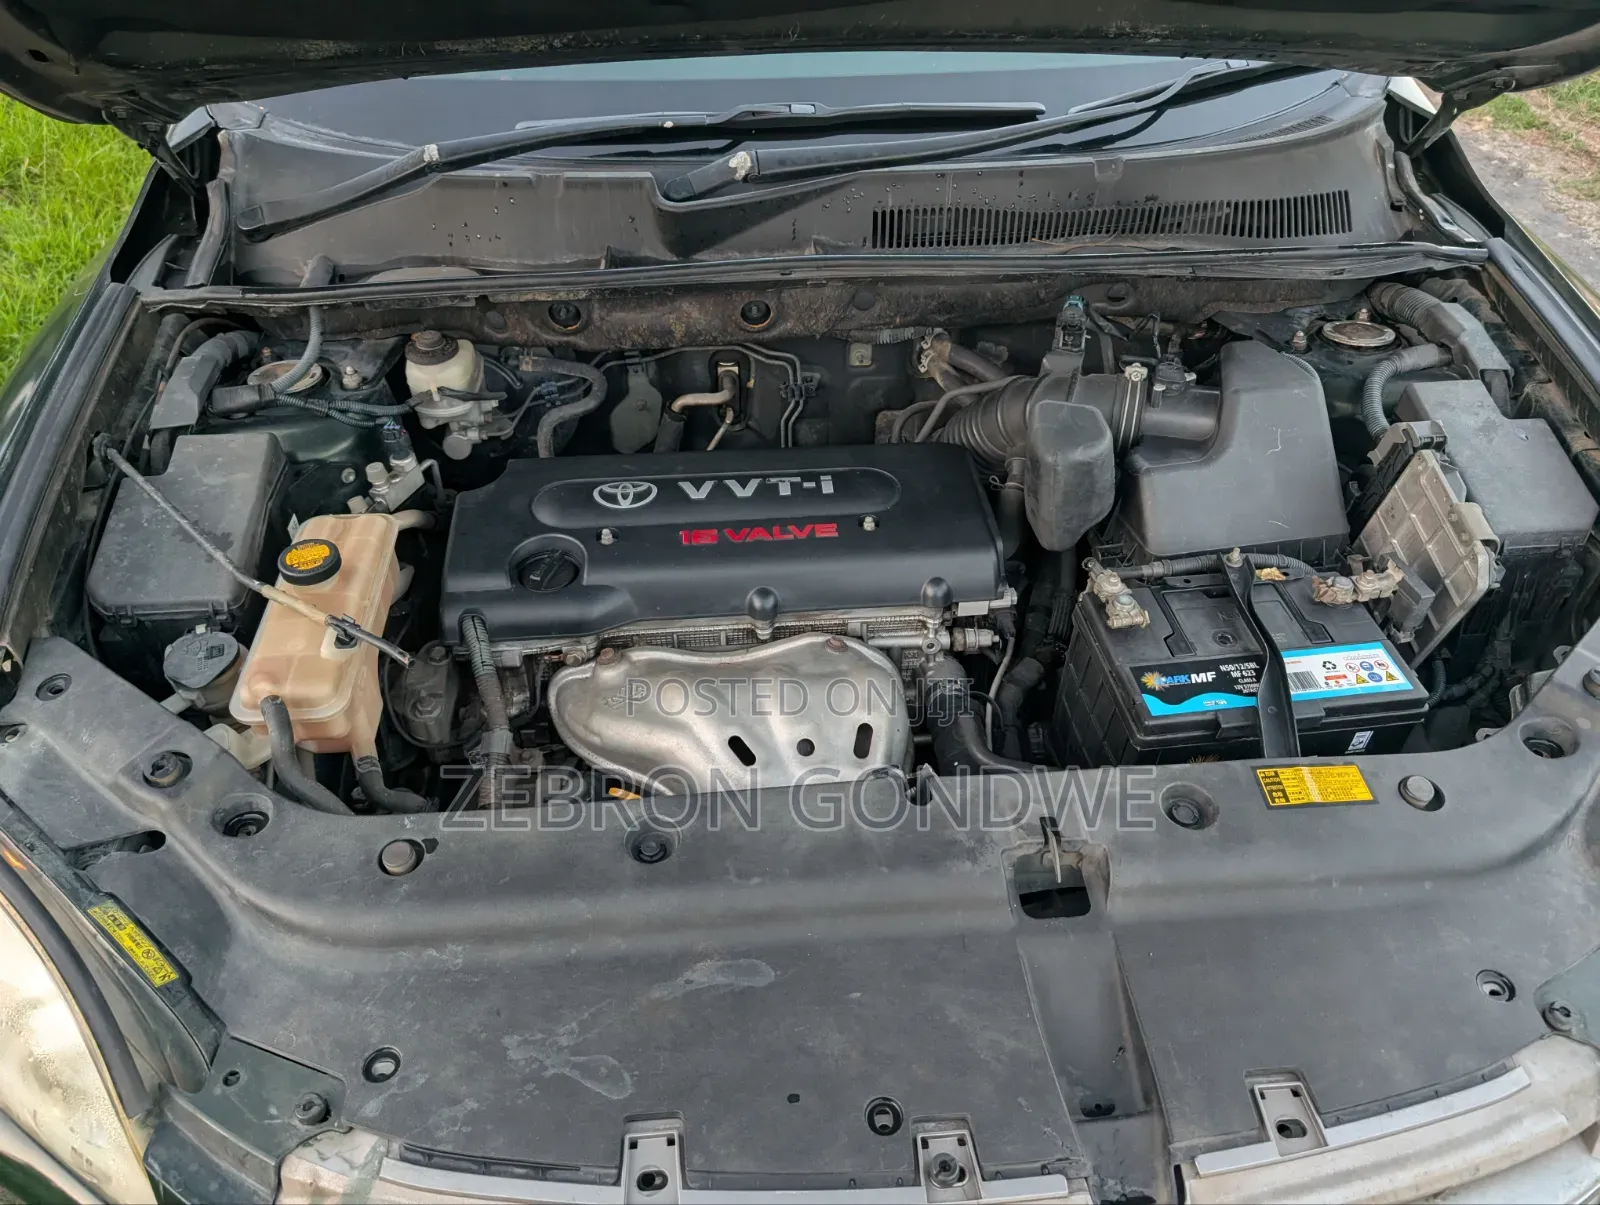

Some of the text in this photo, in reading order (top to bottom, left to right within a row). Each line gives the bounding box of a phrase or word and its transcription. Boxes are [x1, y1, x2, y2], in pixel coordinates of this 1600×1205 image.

[677, 475, 835, 500] VVT-i
[679, 522, 839, 546] 16 VALVE
[1190, 671, 1216, 684] MF
